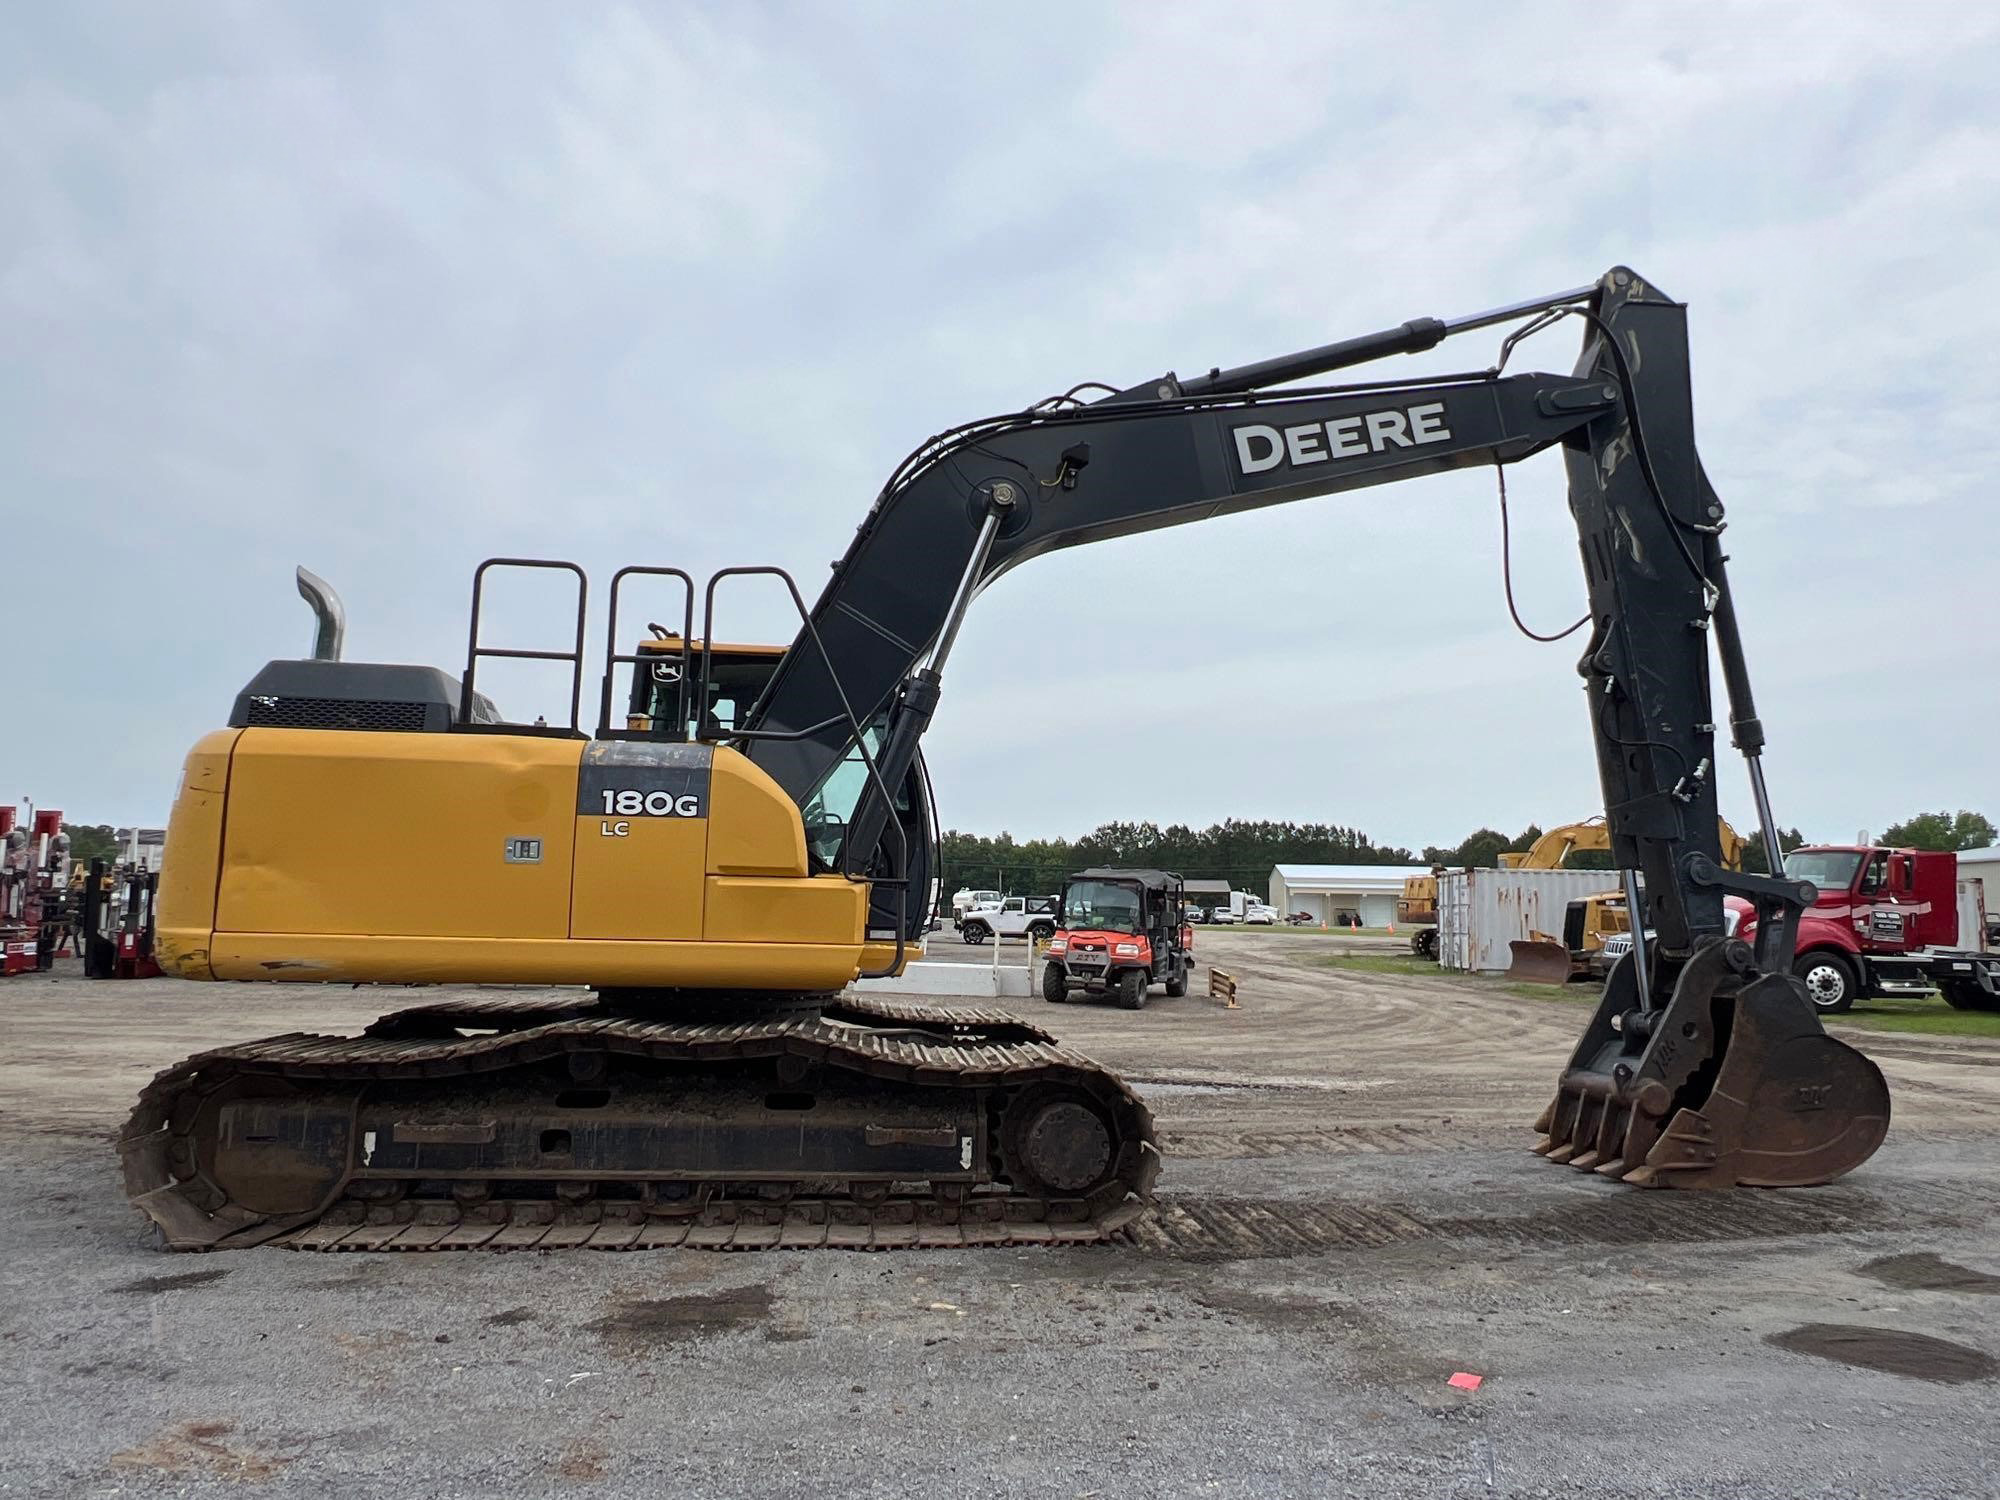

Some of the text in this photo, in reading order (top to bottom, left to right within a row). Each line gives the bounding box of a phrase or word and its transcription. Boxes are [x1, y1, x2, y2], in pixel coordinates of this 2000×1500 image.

[1233, 403, 1451, 474] DEERE
[602, 790, 698, 817] 180G
[601, 822, 629, 836] LC
